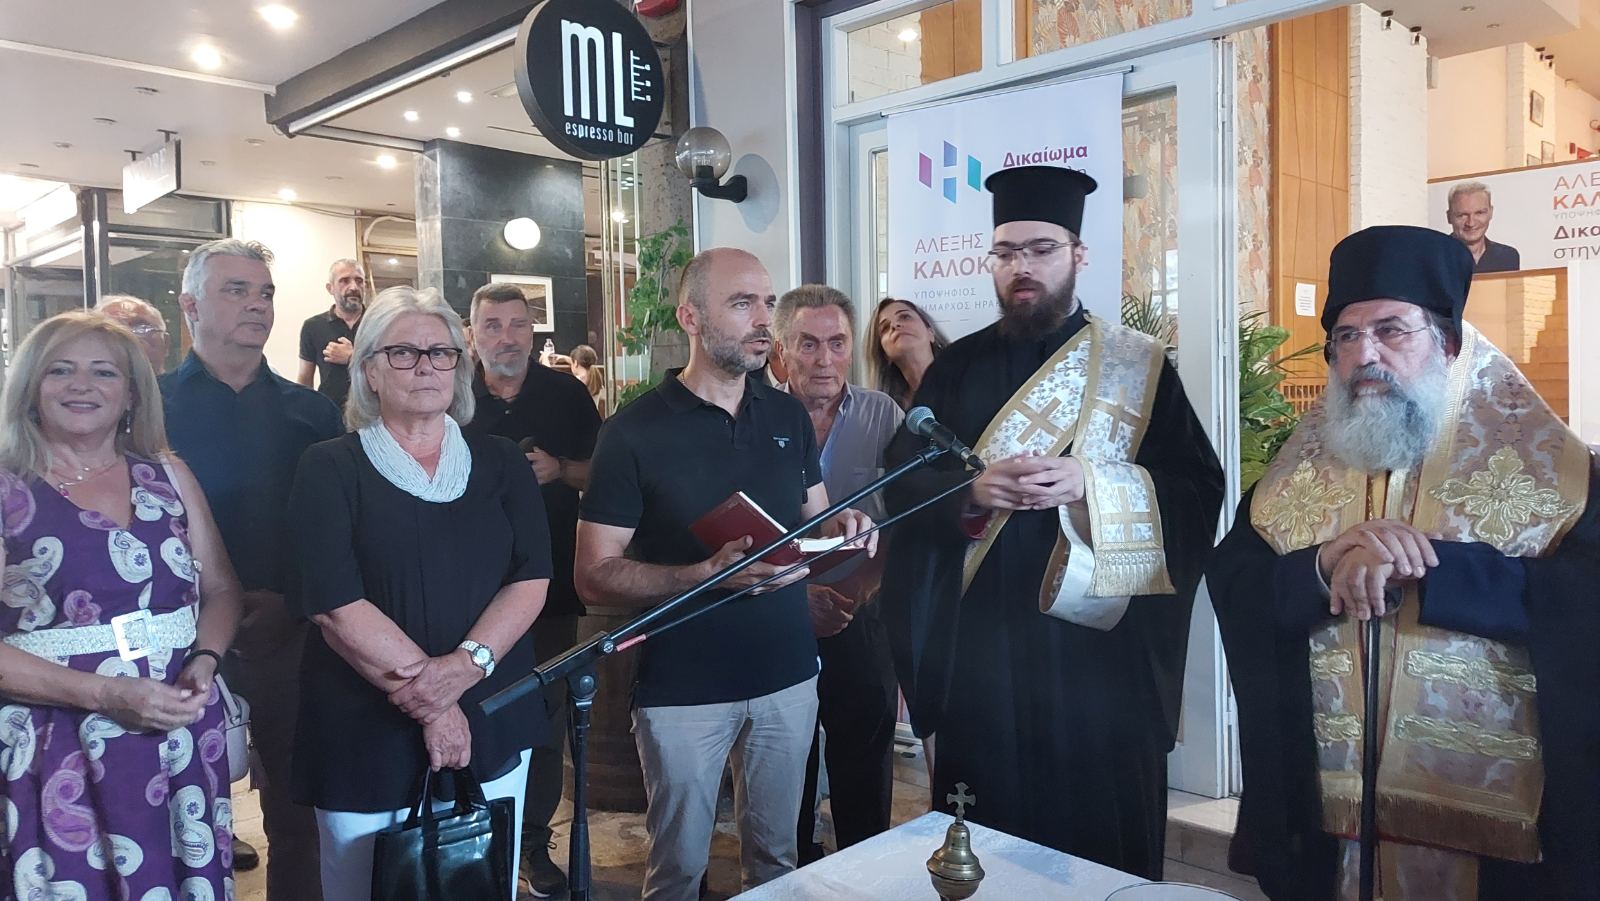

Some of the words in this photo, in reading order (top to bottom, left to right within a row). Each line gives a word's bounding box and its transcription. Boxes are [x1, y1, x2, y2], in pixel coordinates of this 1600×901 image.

[565, 121, 614, 142] espresso
[617, 128, 634, 145] bar
[1003, 146, 1088, 168] Δικαίωμα
[914, 232, 984, 254] ΑΛΕΞΗΣ
[914, 287, 977, 299] ΥΠΟΨΗΦΙΟΣ
[921, 301, 970, 312] ΗΜΑΡΧΟΣ
